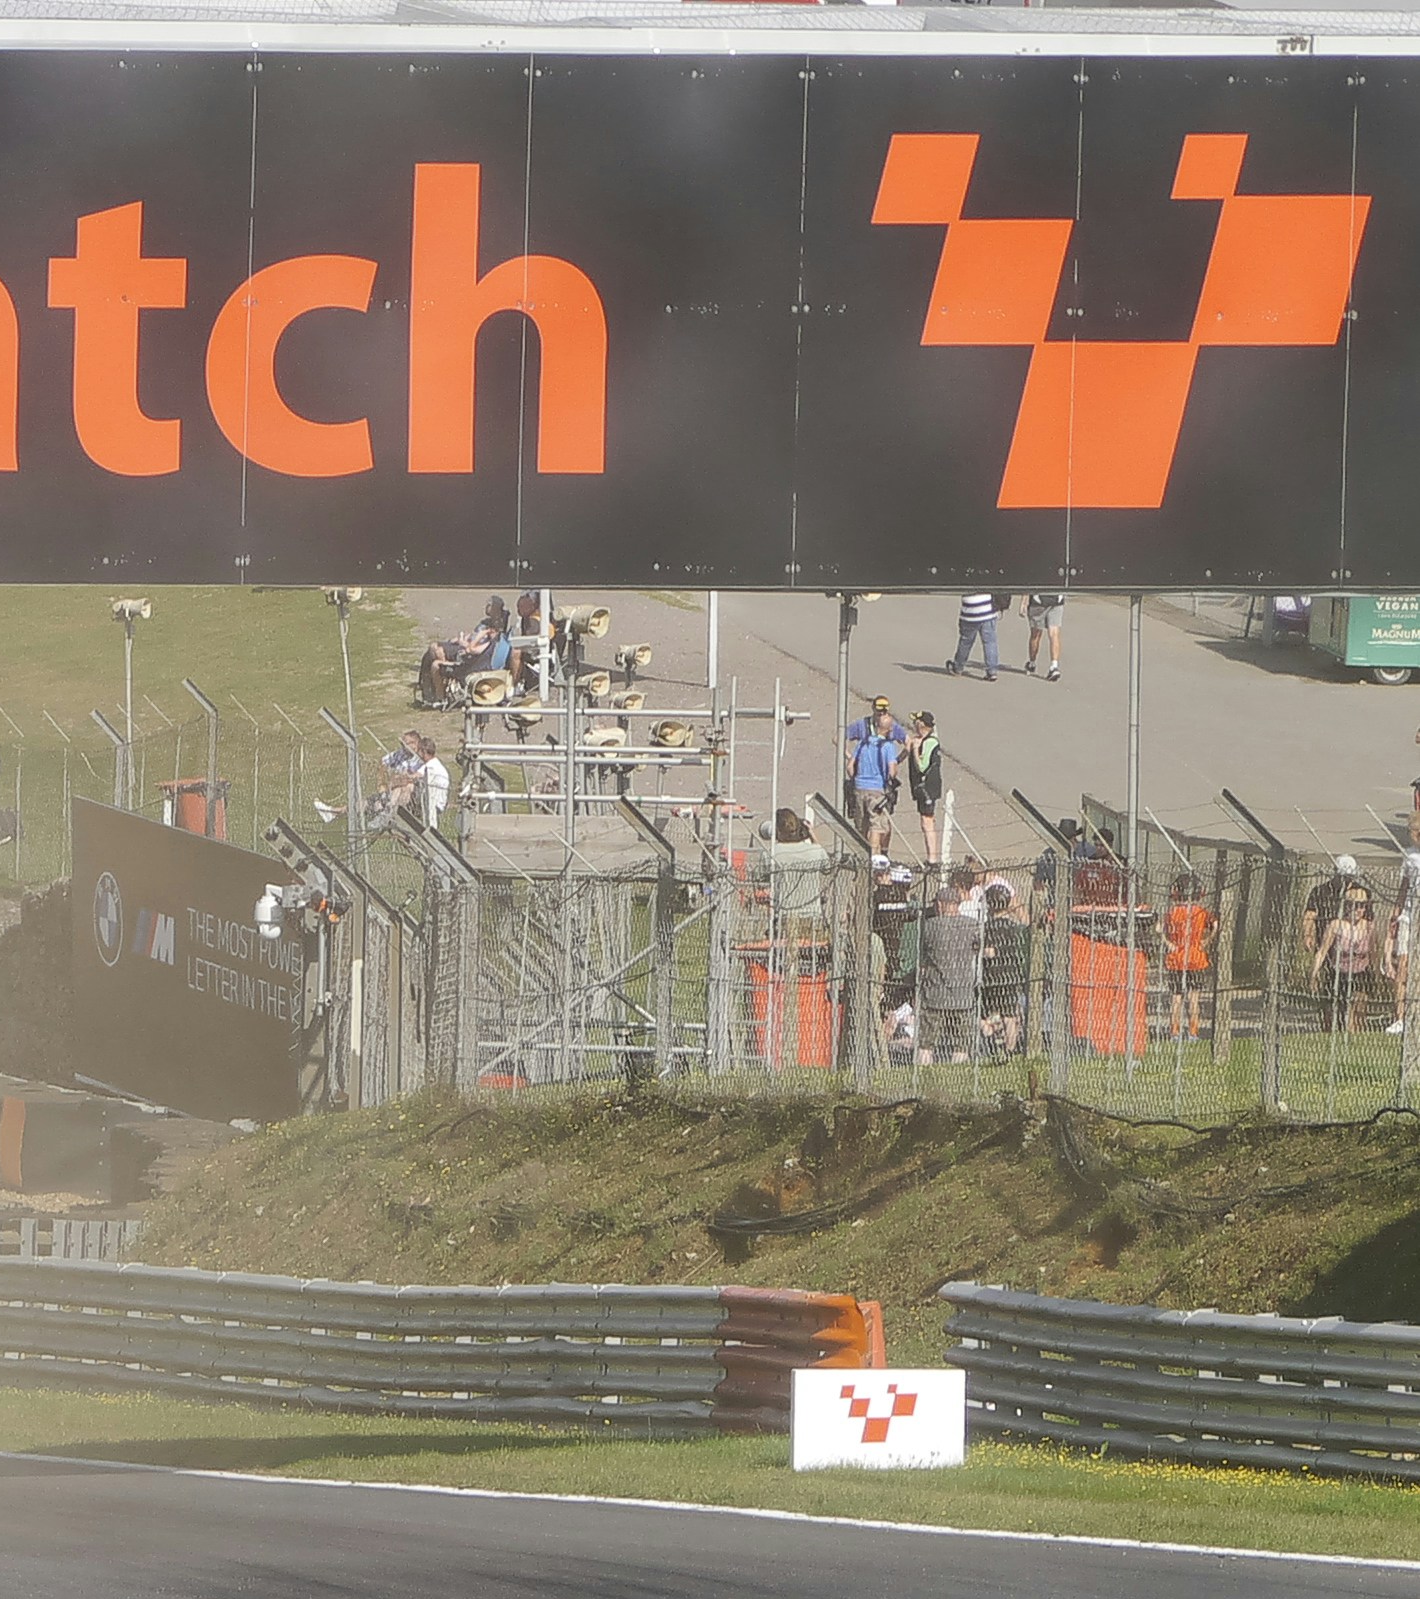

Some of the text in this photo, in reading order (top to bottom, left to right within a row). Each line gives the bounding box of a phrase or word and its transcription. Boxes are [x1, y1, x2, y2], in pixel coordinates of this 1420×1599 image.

[1375, 601, 1419, 610] VEGAN
[1372, 628, 1420, 639] MAGNUM
[151, 913, 175, 966] M
[187, 907, 301, 977] THE MOST POWE
[187, 955, 239, 1005] LETTER
[241, 975, 256, 1011] IN
[258, 979, 287, 1021] THE
